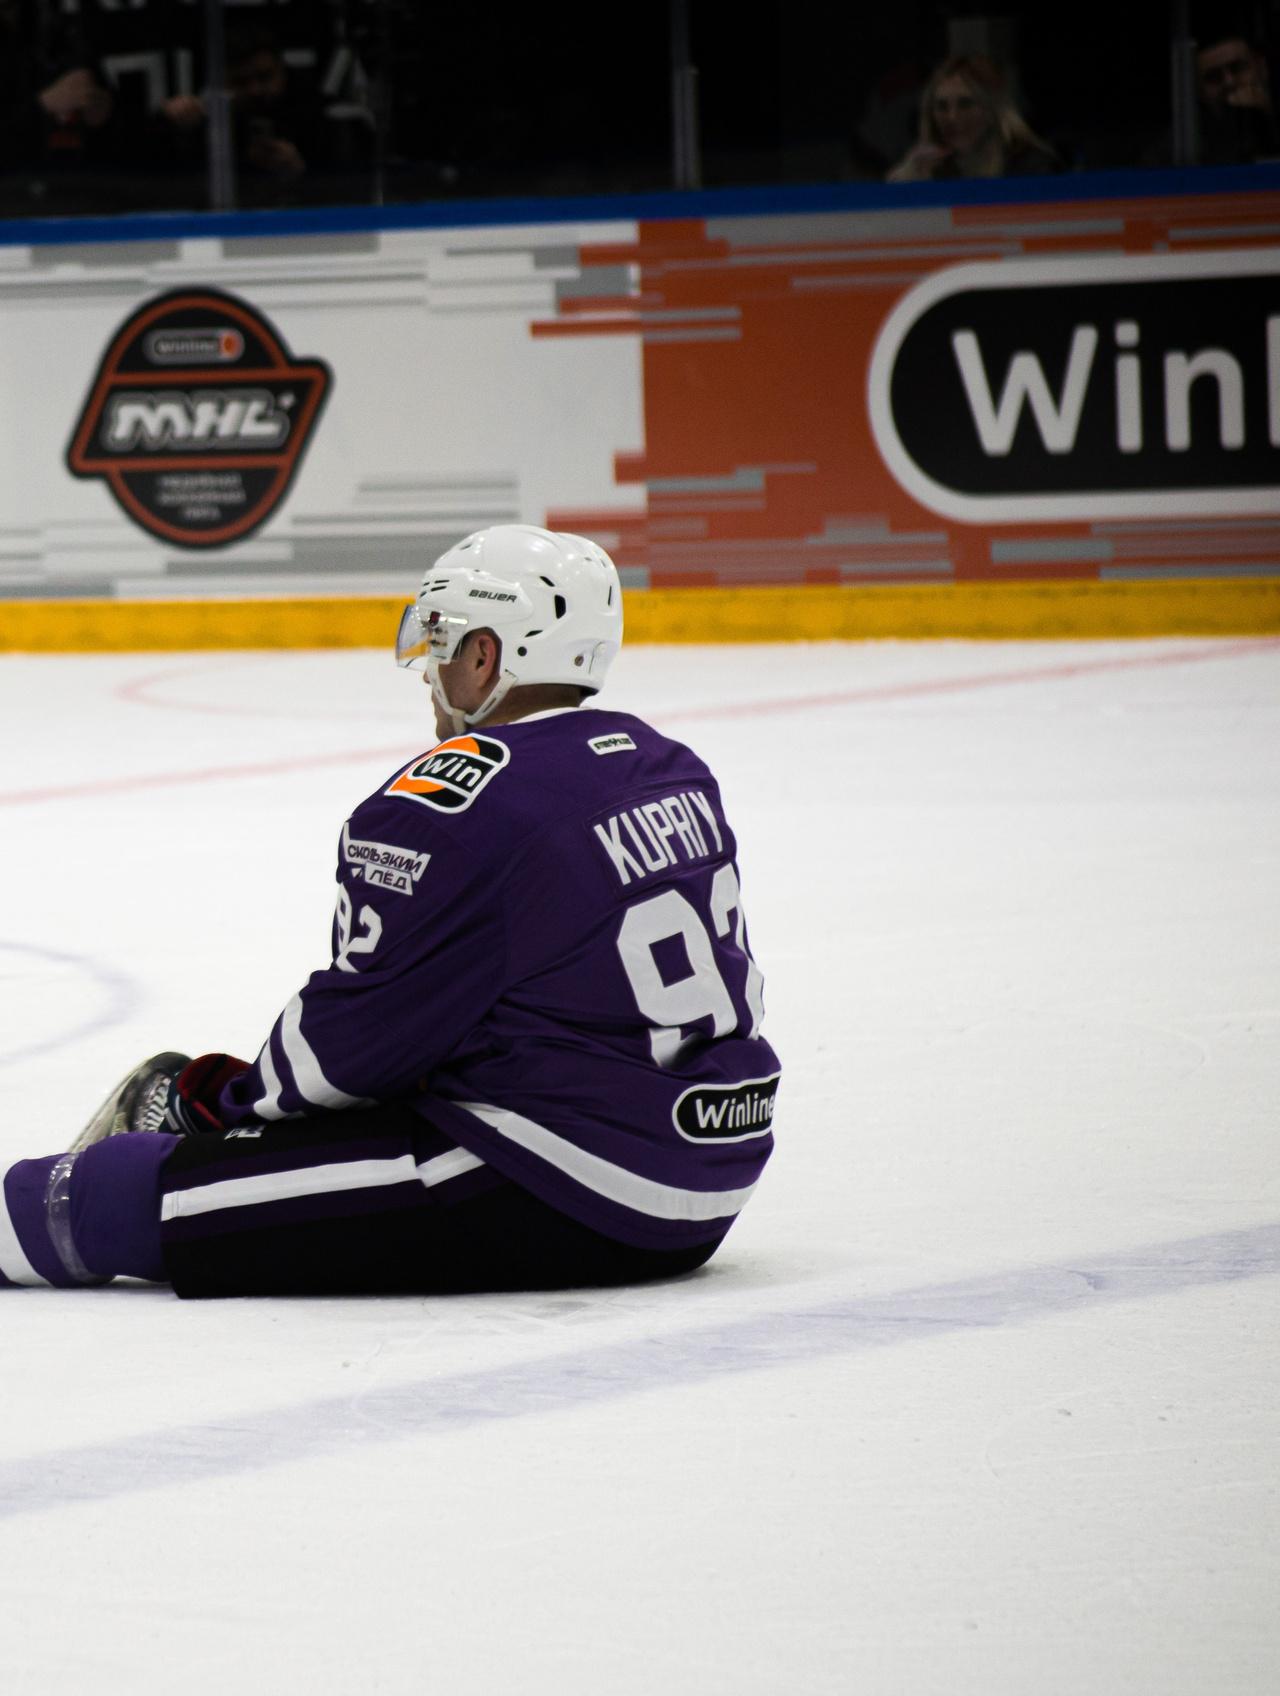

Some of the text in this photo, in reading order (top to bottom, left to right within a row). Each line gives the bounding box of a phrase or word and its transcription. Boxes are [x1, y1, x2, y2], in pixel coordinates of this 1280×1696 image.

[420, 756, 482, 788] Win
[593, 791, 723, 886] KUPRIY
[369, 869, 408, 890] ЛЁД
[335, 882, 383, 974] 92
[695, 1092, 776, 1129] Winline
